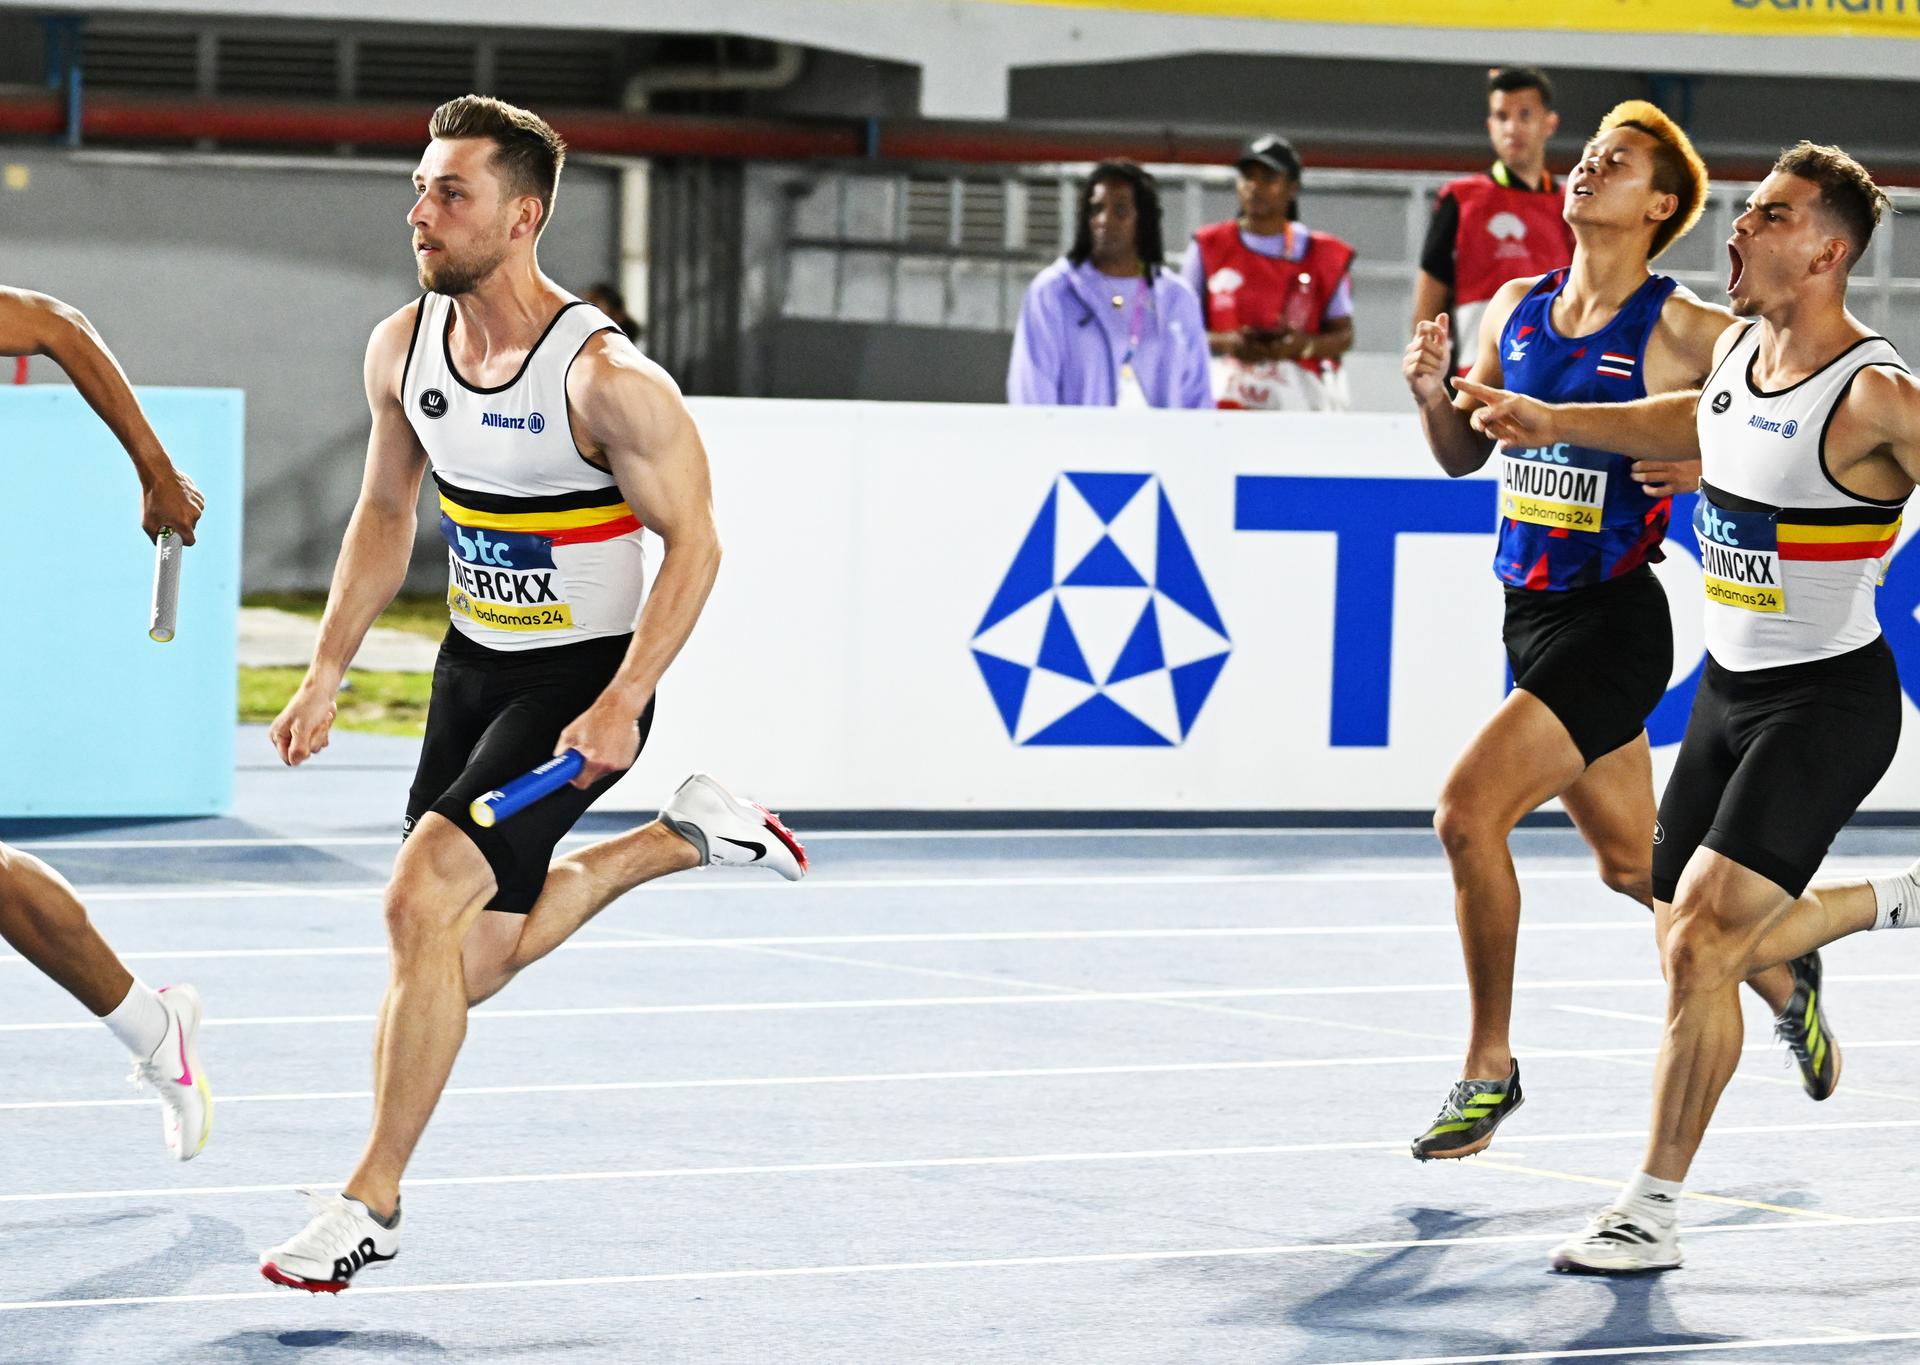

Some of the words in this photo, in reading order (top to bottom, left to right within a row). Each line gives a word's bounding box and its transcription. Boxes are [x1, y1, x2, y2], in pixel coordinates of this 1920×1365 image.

[481, 412, 525, 429] Allianz
[1748, 414, 1781, 433] Allianz
[1503, 460, 1598, 504] AMUDOM
[1520, 502, 1594, 525] bahamas24
[456, 525, 513, 567] btc
[452, 555, 558, 604] MERCKX
[474, 606, 563, 625] bahamas24
